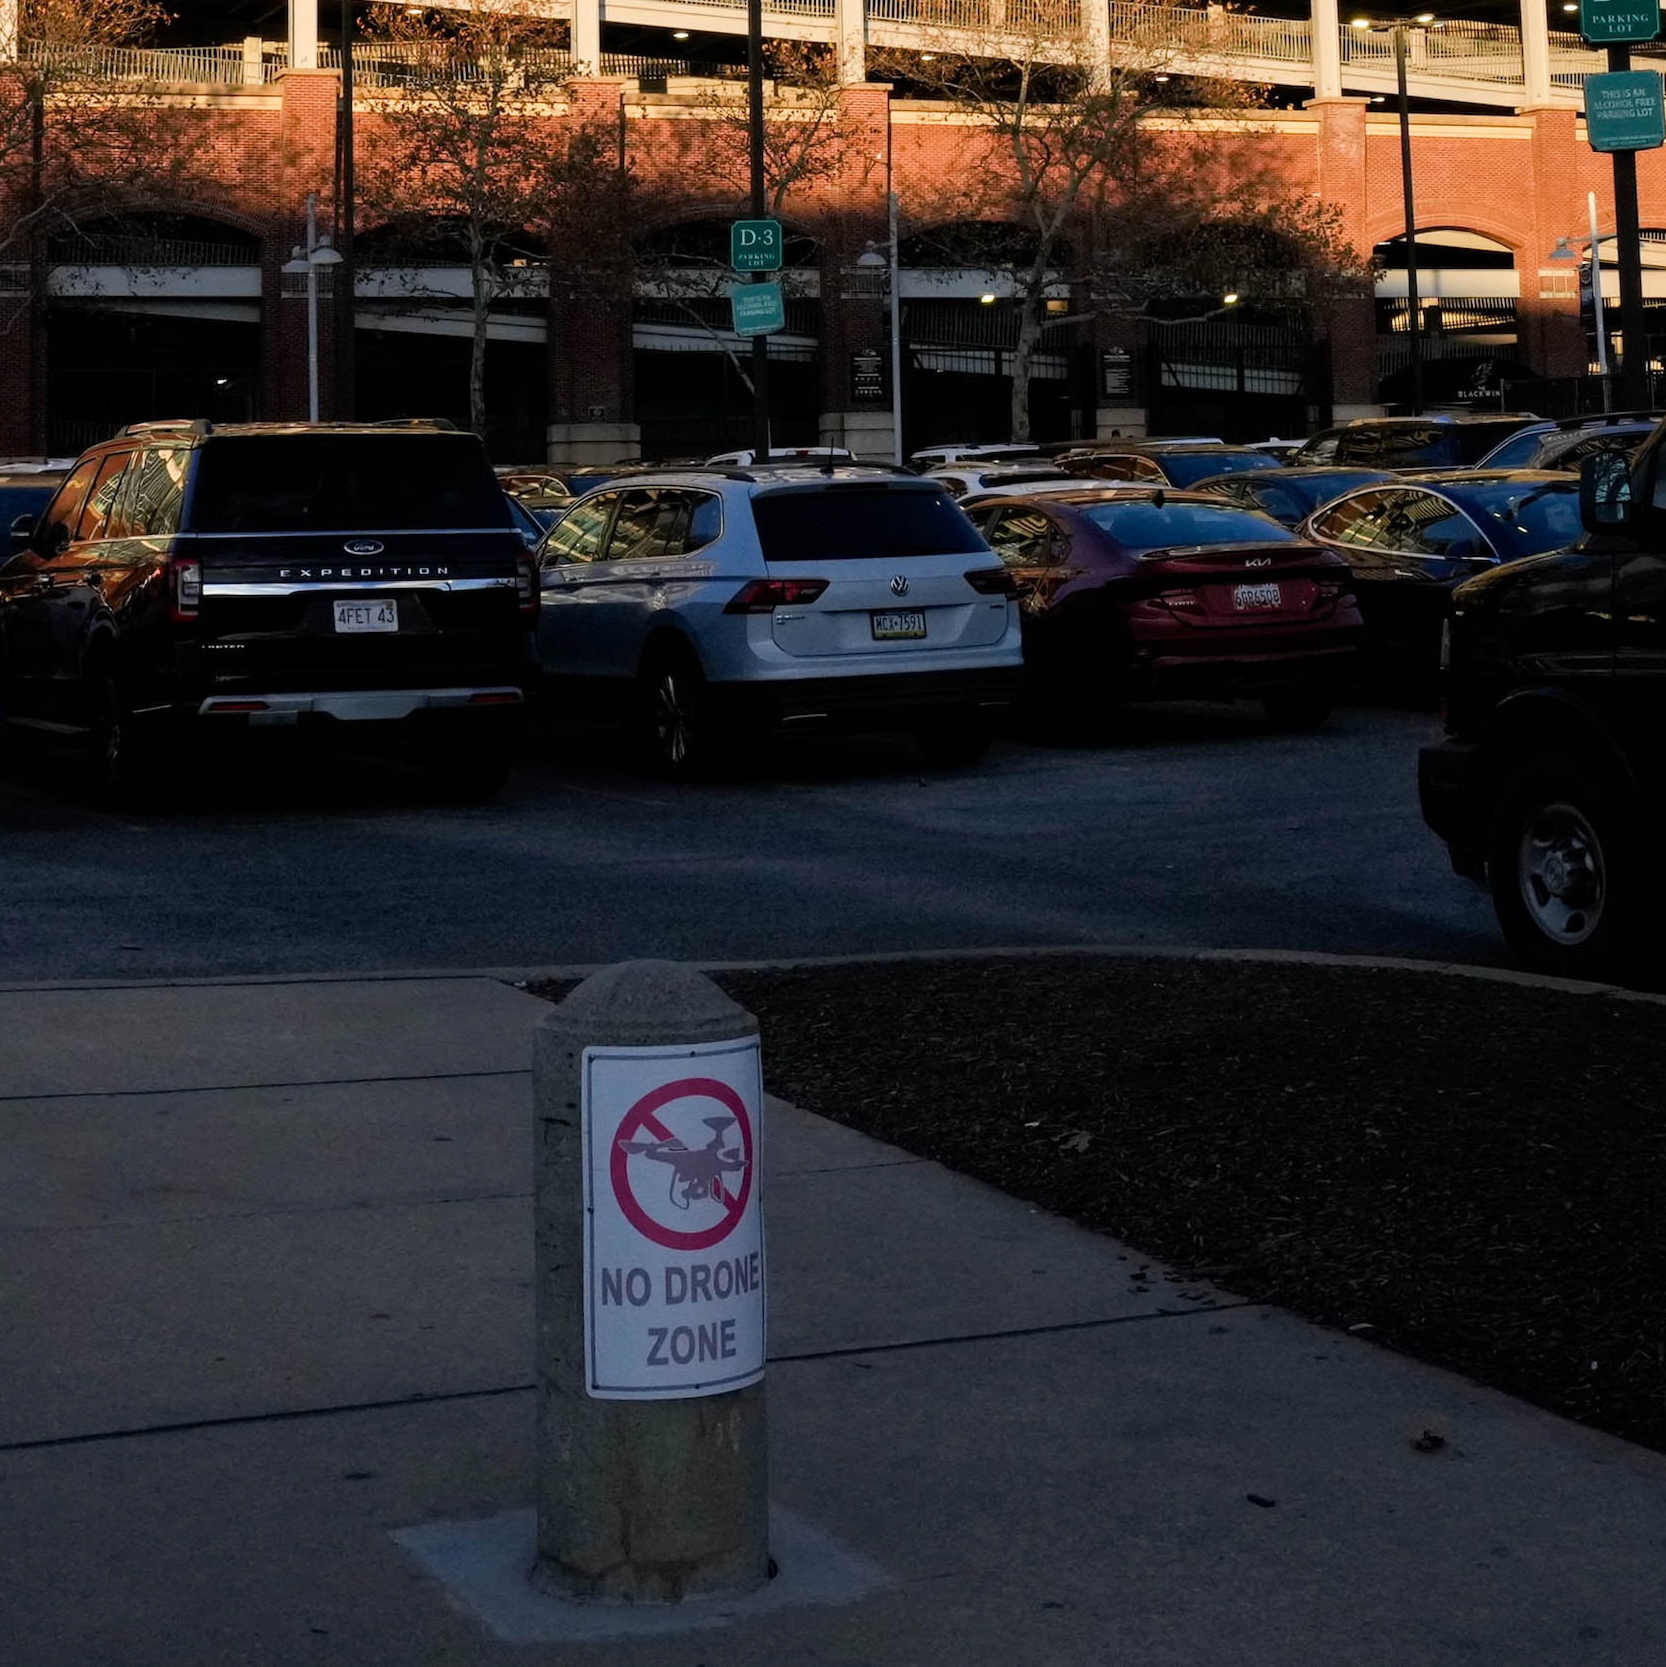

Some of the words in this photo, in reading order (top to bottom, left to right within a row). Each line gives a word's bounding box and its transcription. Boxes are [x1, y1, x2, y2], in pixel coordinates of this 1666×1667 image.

[1592, 13, 1649, 25] PARKING
[1608, 24, 1633, 33] LOT
[1601, 90, 1621, 99] THIS
[1623, 89, 1631, 98] IS
[1593, 99, 1634, 110] ALCOHOL
[1635, 97, 1657, 107] FREE
[1637, 107, 1654, 117] LOT
[1457, 389, 1501, 398] BLACKWIN
[280, 566, 449, 578] EXPEDITION
[601, 1267, 651, 1306] NO
[664, 1250, 760, 1306] DRONE
[646, 1318, 737, 1367] ZONE
